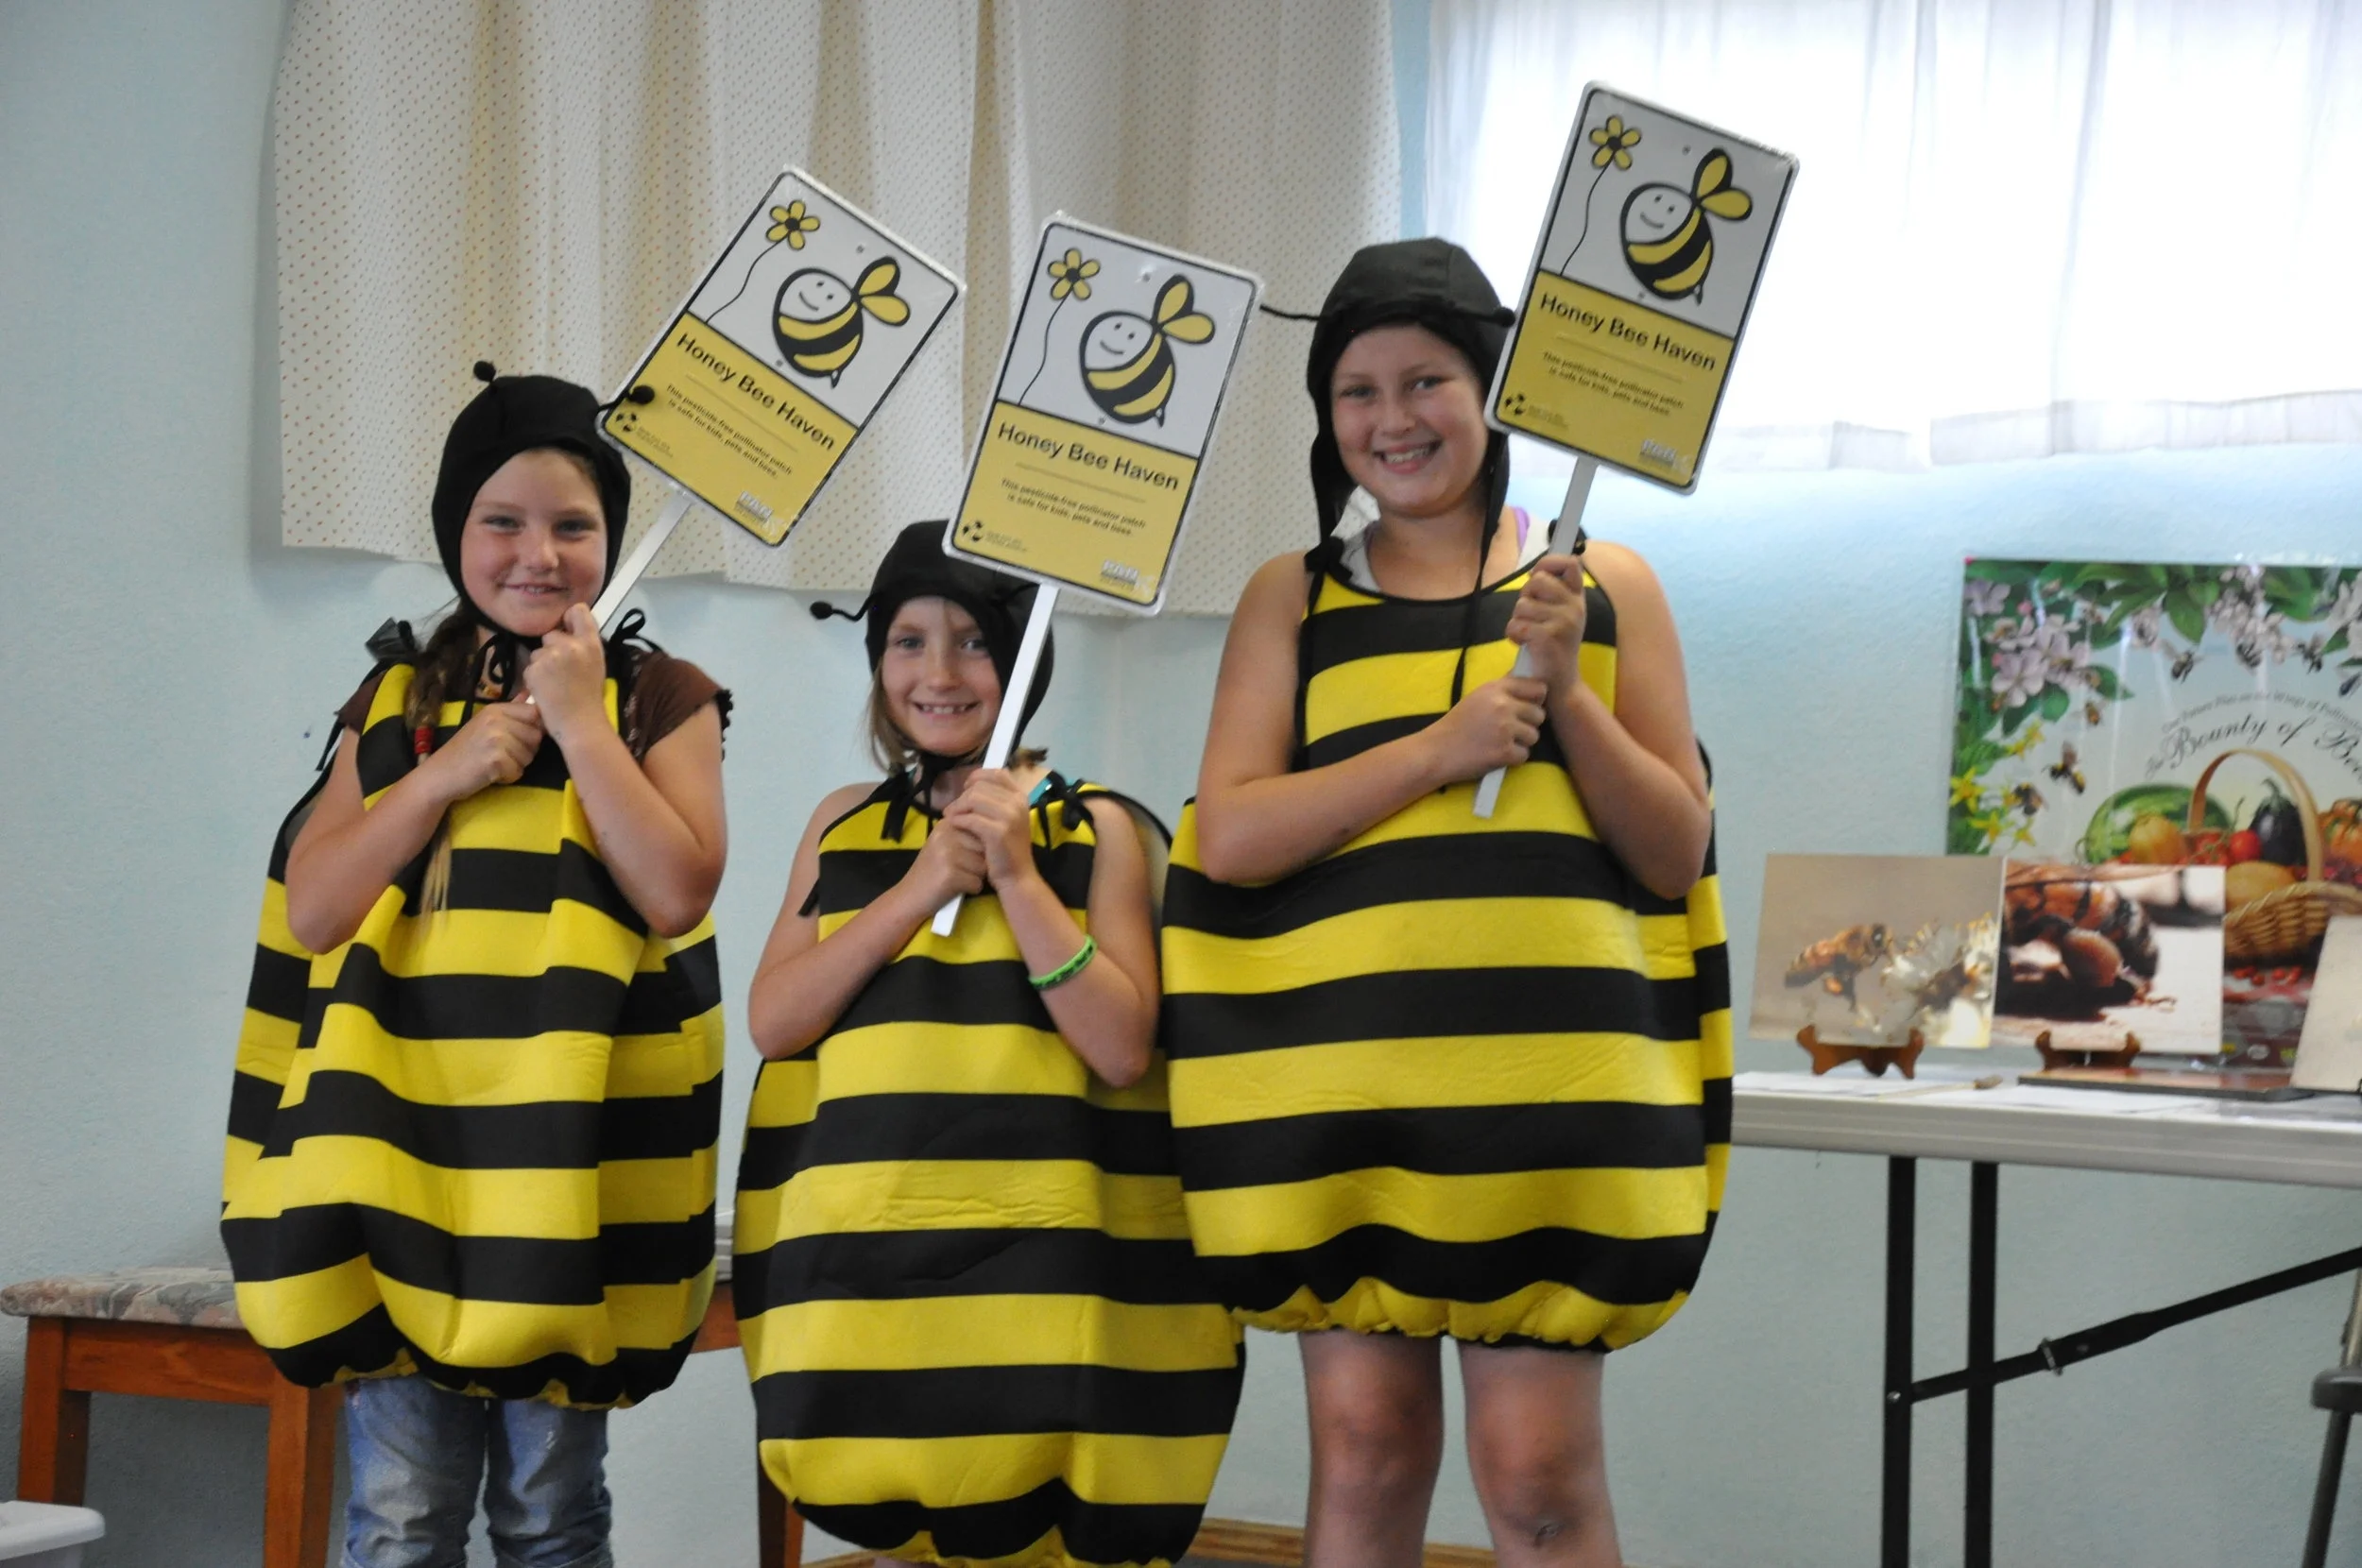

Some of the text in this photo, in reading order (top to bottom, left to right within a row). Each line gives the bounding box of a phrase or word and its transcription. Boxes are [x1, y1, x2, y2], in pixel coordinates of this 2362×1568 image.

[1540, 292, 1716, 371] Honey Bee Haven
[676, 332, 835, 451] Honey Bee Haven
[667, 384, 682, 399] This
[733, 432, 769, 458] pollinator
[770, 457, 792, 475] patch
[668, 399, 676, 407] is
[677, 406, 693, 419] safe
[694, 417, 706, 427] for
[724, 439, 743, 452] pets
[743, 451, 759, 464] and
[999, 422, 1179, 491] Honey Bee Haven
[1001, 478, 1018, 490] This
[1078, 503, 1120, 520] pollinator
[1121, 516, 1146, 529] patch
[1007, 493, 1015, 502] is
[1017, 496, 1035, 507] safe
[1036, 501, 1049, 511] for
[1071, 512, 1091, 524] pets
[1092, 519, 1109, 529] and
[2159, 712, 2268, 770] Bounty
[2277, 715, 2318, 747] of
[2313, 722, 2362, 787] Bee
